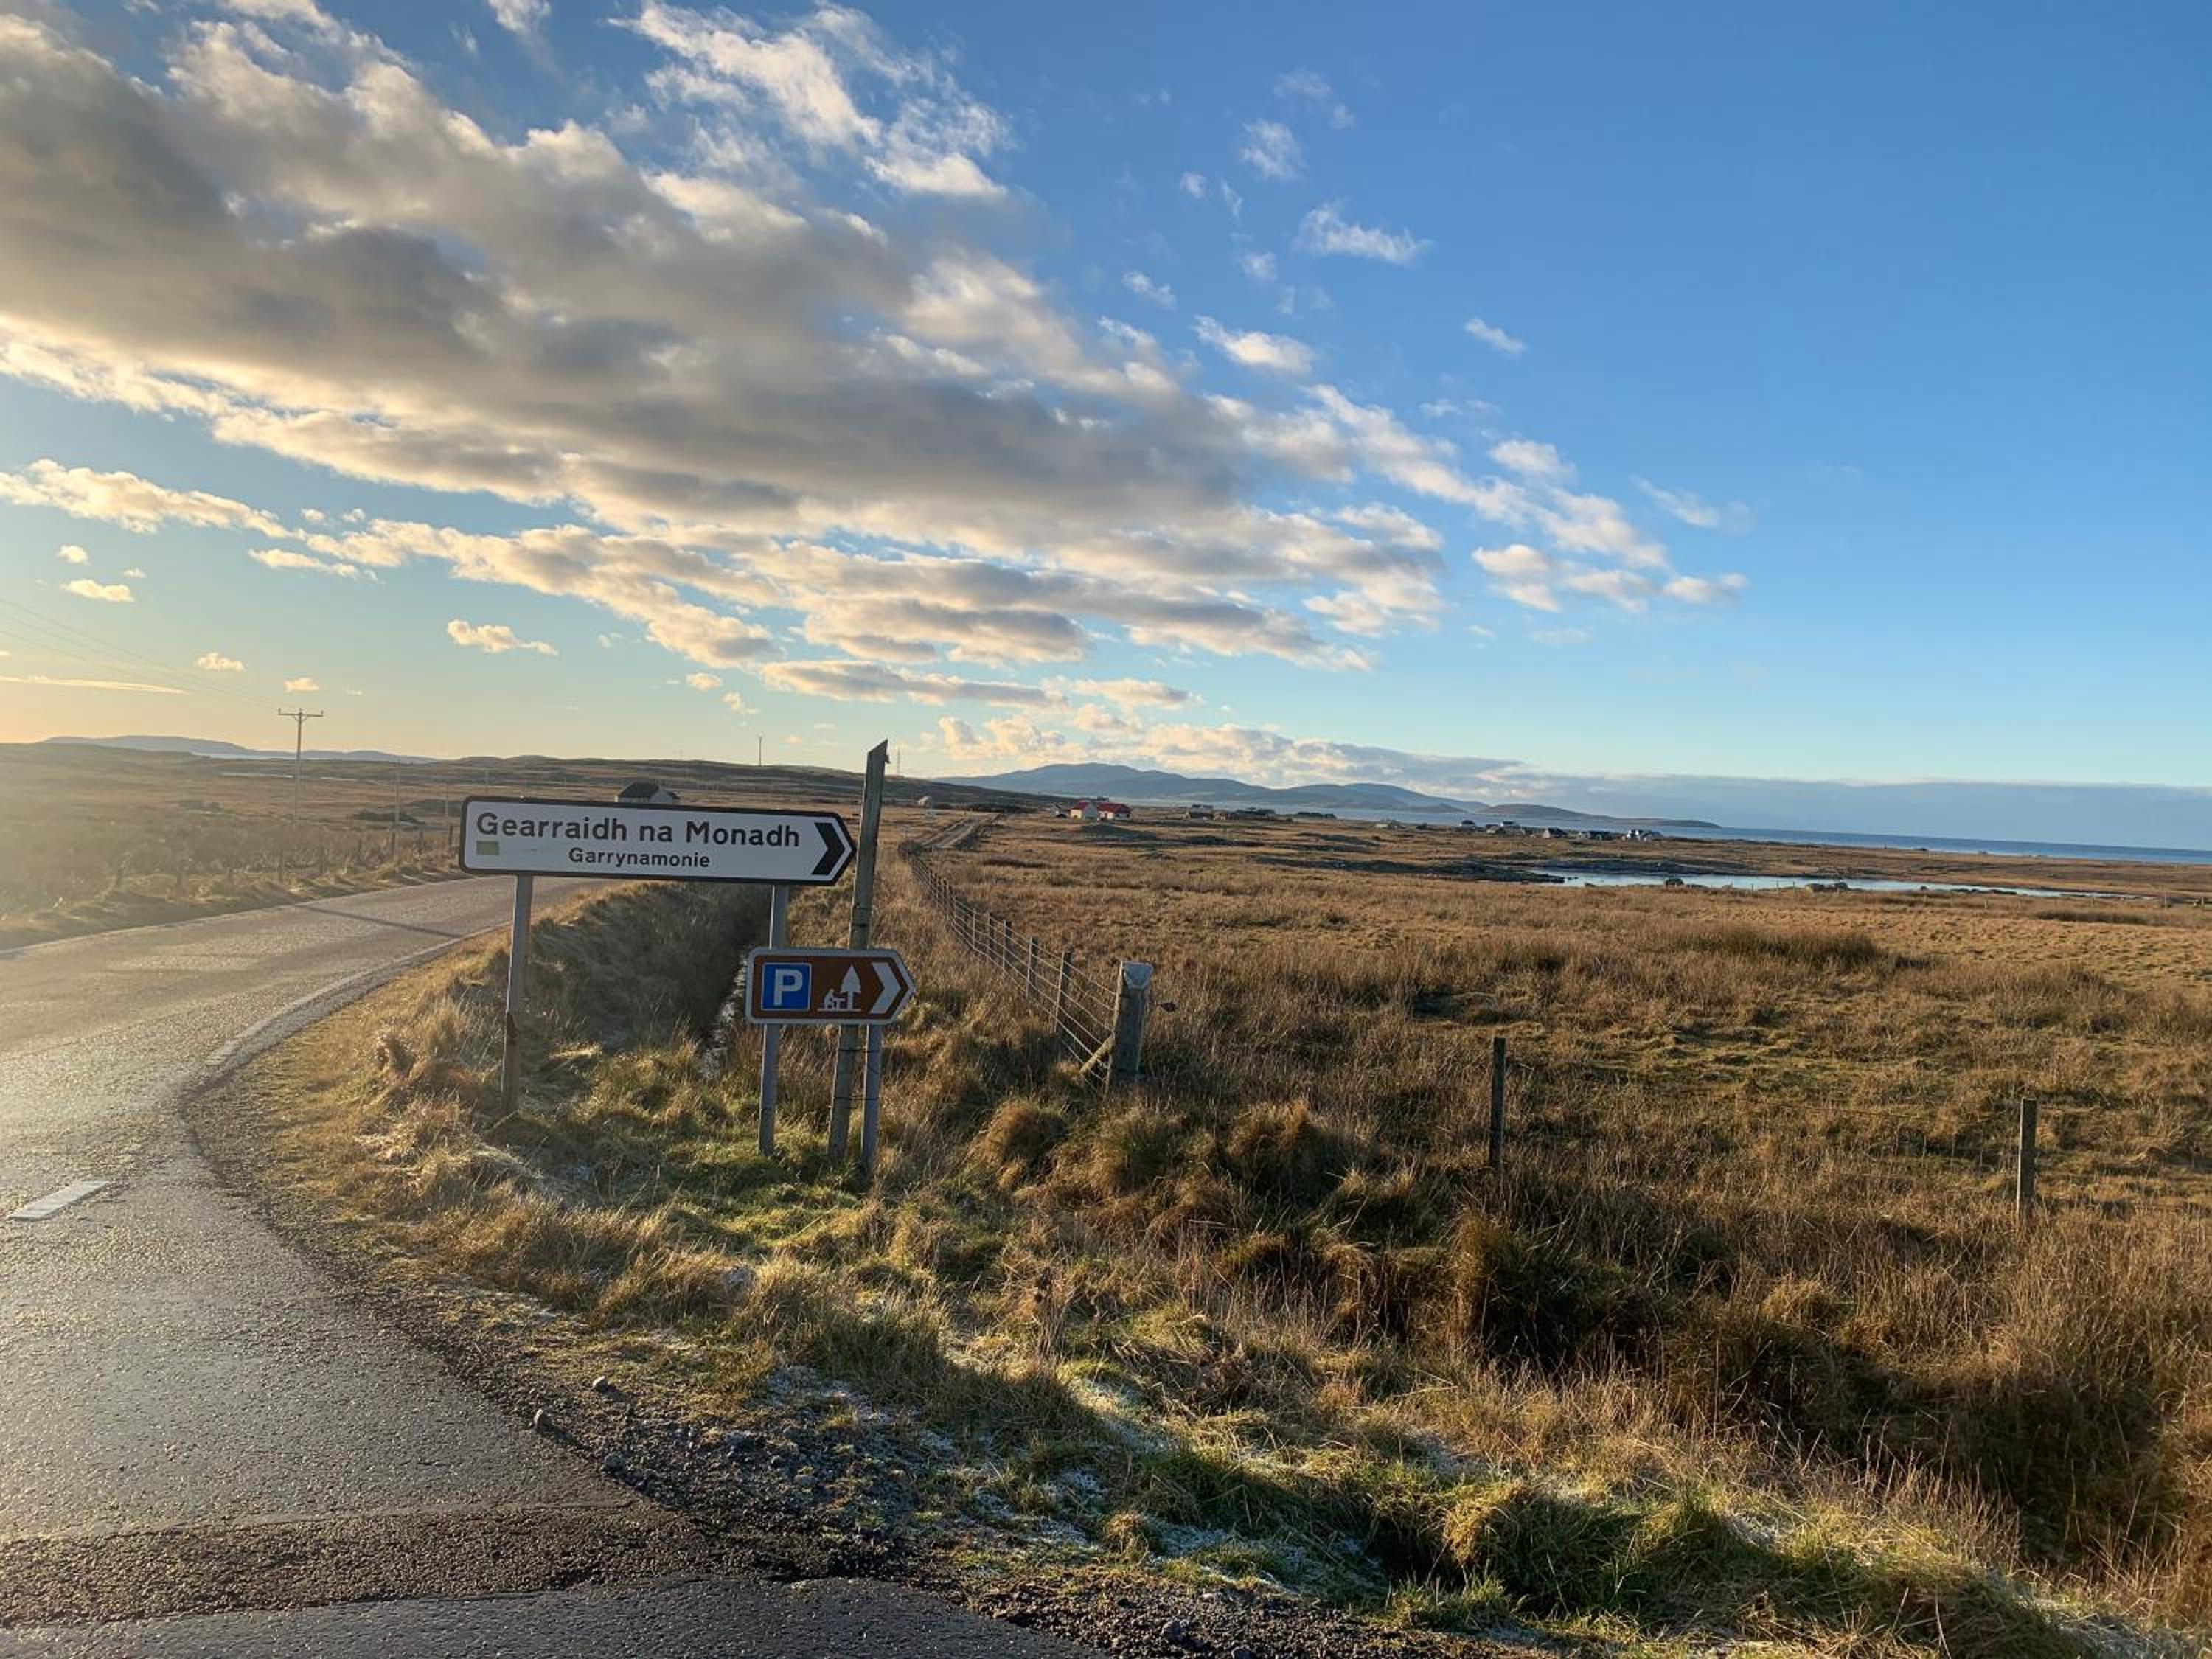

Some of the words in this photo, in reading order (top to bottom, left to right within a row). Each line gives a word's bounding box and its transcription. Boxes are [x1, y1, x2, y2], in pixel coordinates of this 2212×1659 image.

[476, 812, 627, 842] Gearraidh
[639, 824, 673, 843] na
[685, 821, 800, 847] Monadh
[568, 847, 710, 868] Garrynamonie
[773, 968, 803, 1006] P
